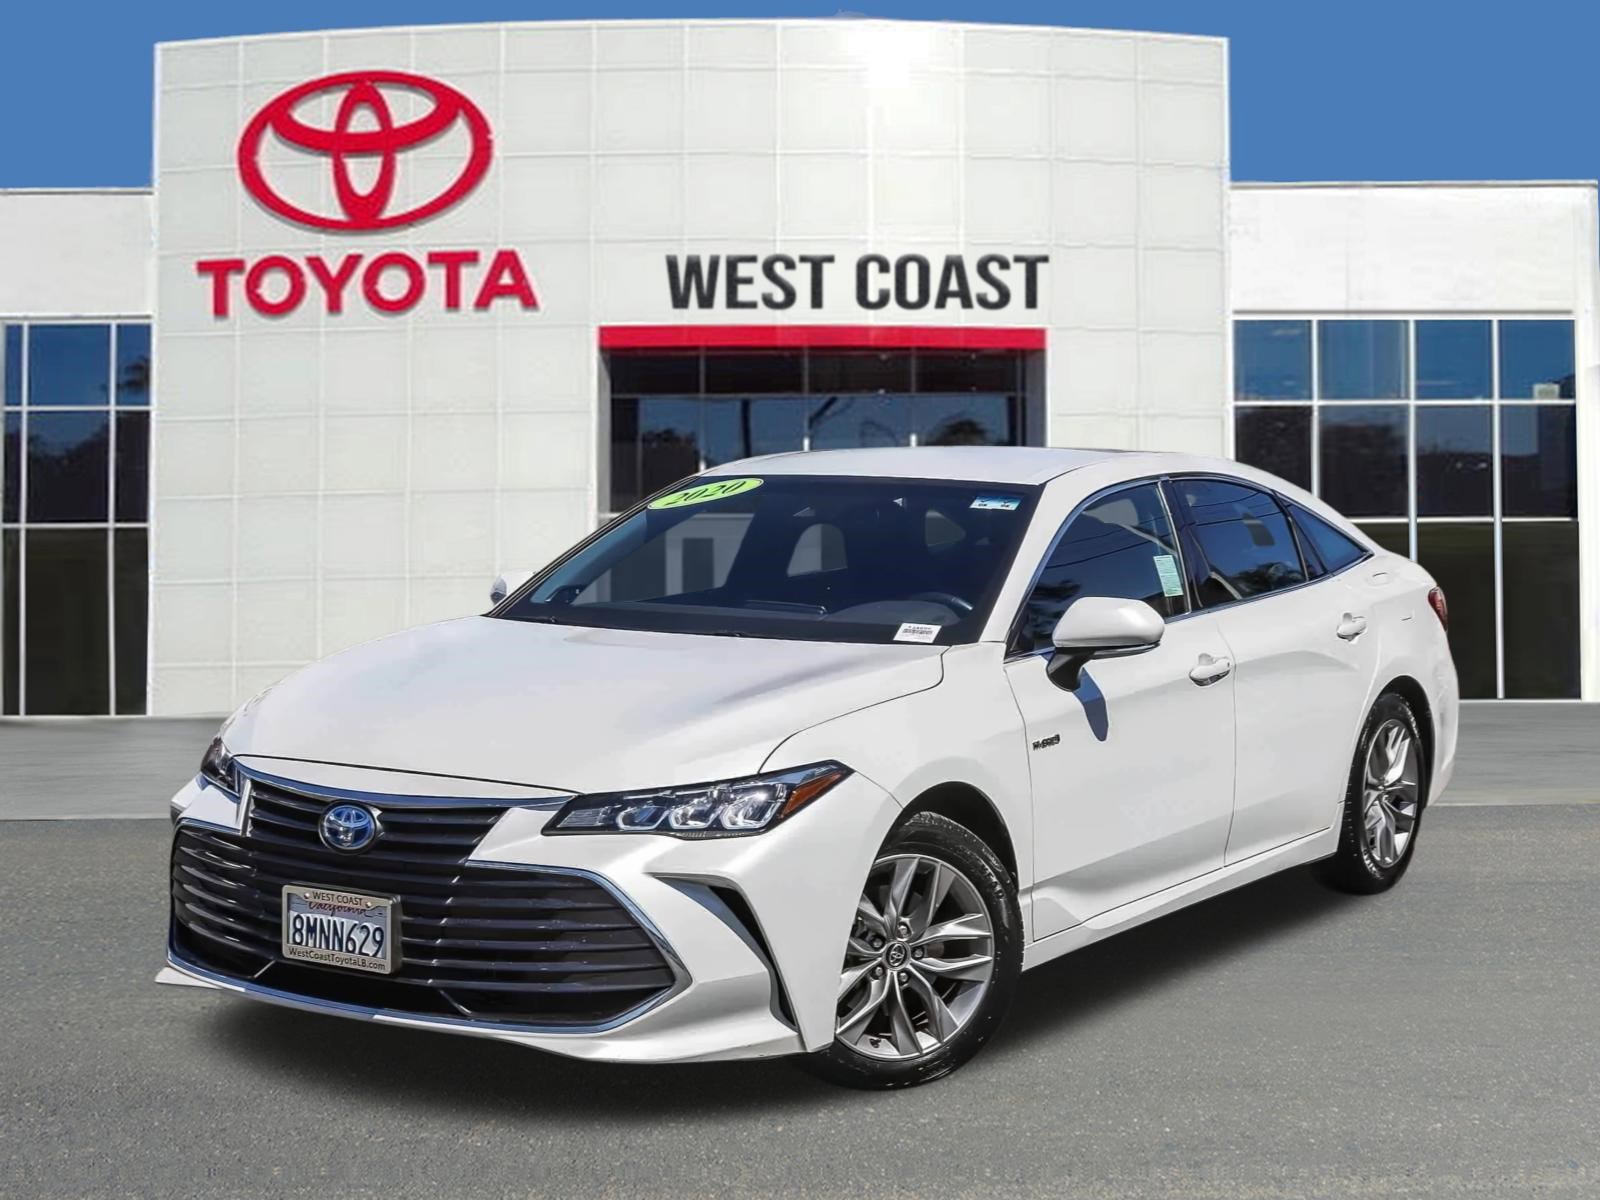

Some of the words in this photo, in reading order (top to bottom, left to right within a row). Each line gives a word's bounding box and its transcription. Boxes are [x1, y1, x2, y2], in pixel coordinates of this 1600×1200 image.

[196, 249, 540, 318] TOYOTA
[665, 253, 836, 310] WEST
[855, 253, 1050, 310] COAST
[663, 481, 747, 506] 2020
[312, 891, 335, 902] WEST
[336, 895, 363, 906] COAST
[292, 914, 385, 957] 8MNN629
[288, 946, 386, 971] WestCoastToyotaLB.com
